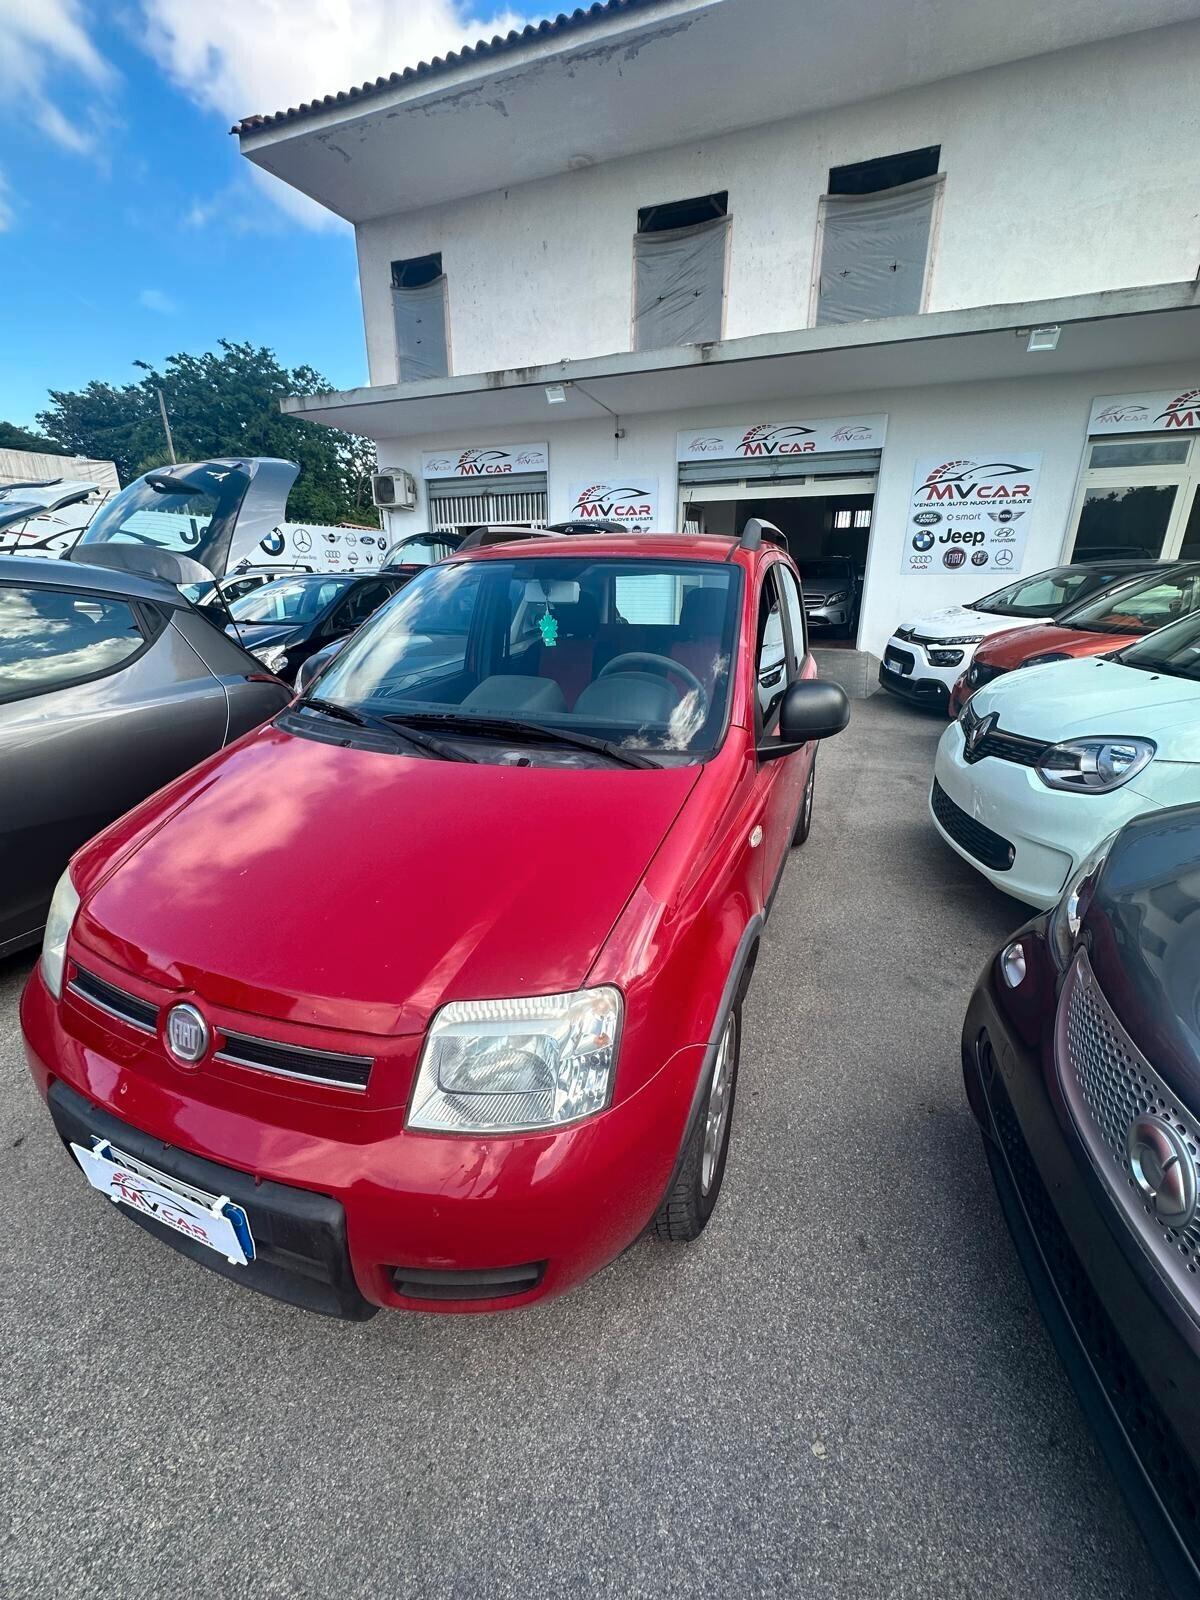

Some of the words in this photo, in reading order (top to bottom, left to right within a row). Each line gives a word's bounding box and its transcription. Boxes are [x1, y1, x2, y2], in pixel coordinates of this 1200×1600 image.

[1165, 410, 1200, 428] M
[743, 441, 816, 456] MVCAR
[461, 463, 513, 476] MVCAR
[926, 482, 1031, 501] MVCAR
[580, 503, 651, 518] MVCAR
[954, 512, 982, 521] smart
[938, 528, 986, 547] Jeep
[947, 553, 962, 564] FIAT
[173, 1018, 199, 1050] FIAT
